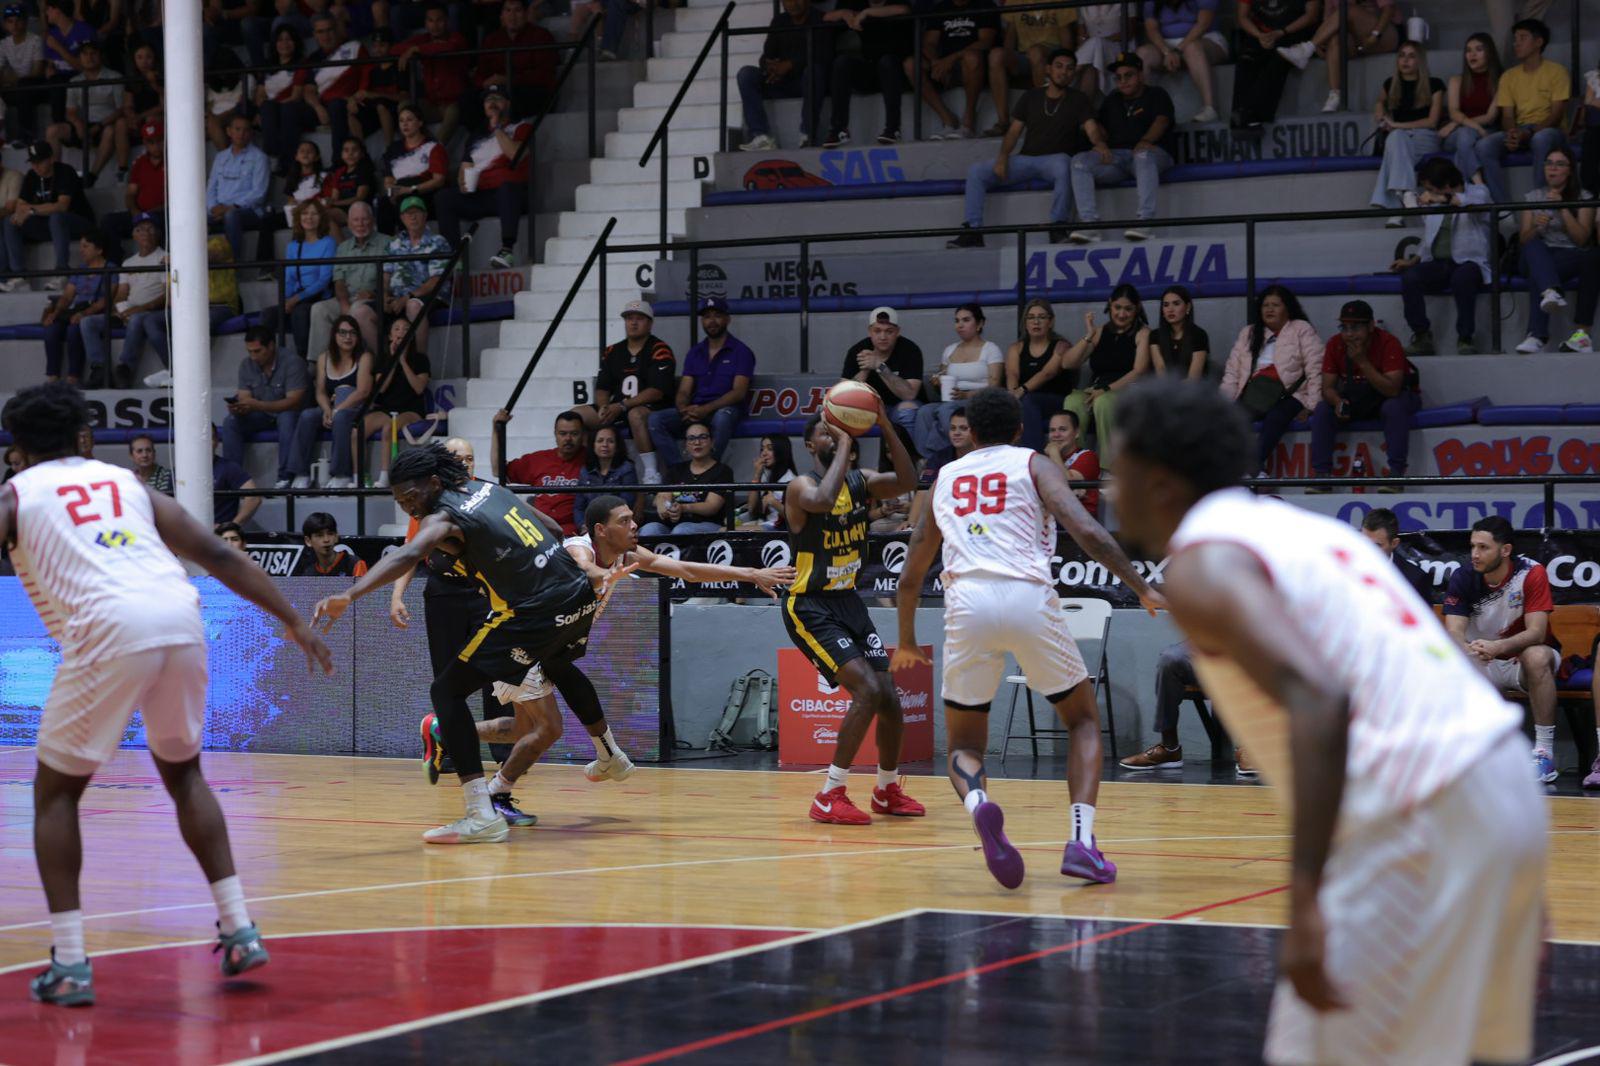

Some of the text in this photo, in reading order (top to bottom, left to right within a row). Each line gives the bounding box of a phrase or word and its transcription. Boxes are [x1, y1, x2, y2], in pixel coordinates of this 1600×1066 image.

[1272, 121, 1360, 158] STUDIO
[694, 156, 710, 179] D
[635, 264, 653, 288] C
[1015, 243, 1229, 290] ASSALIA
[573, 380, 589, 405] B
[56, 480, 122, 526] 27
[951, 472, 1008, 517] 99
[503, 506, 544, 548] 45
